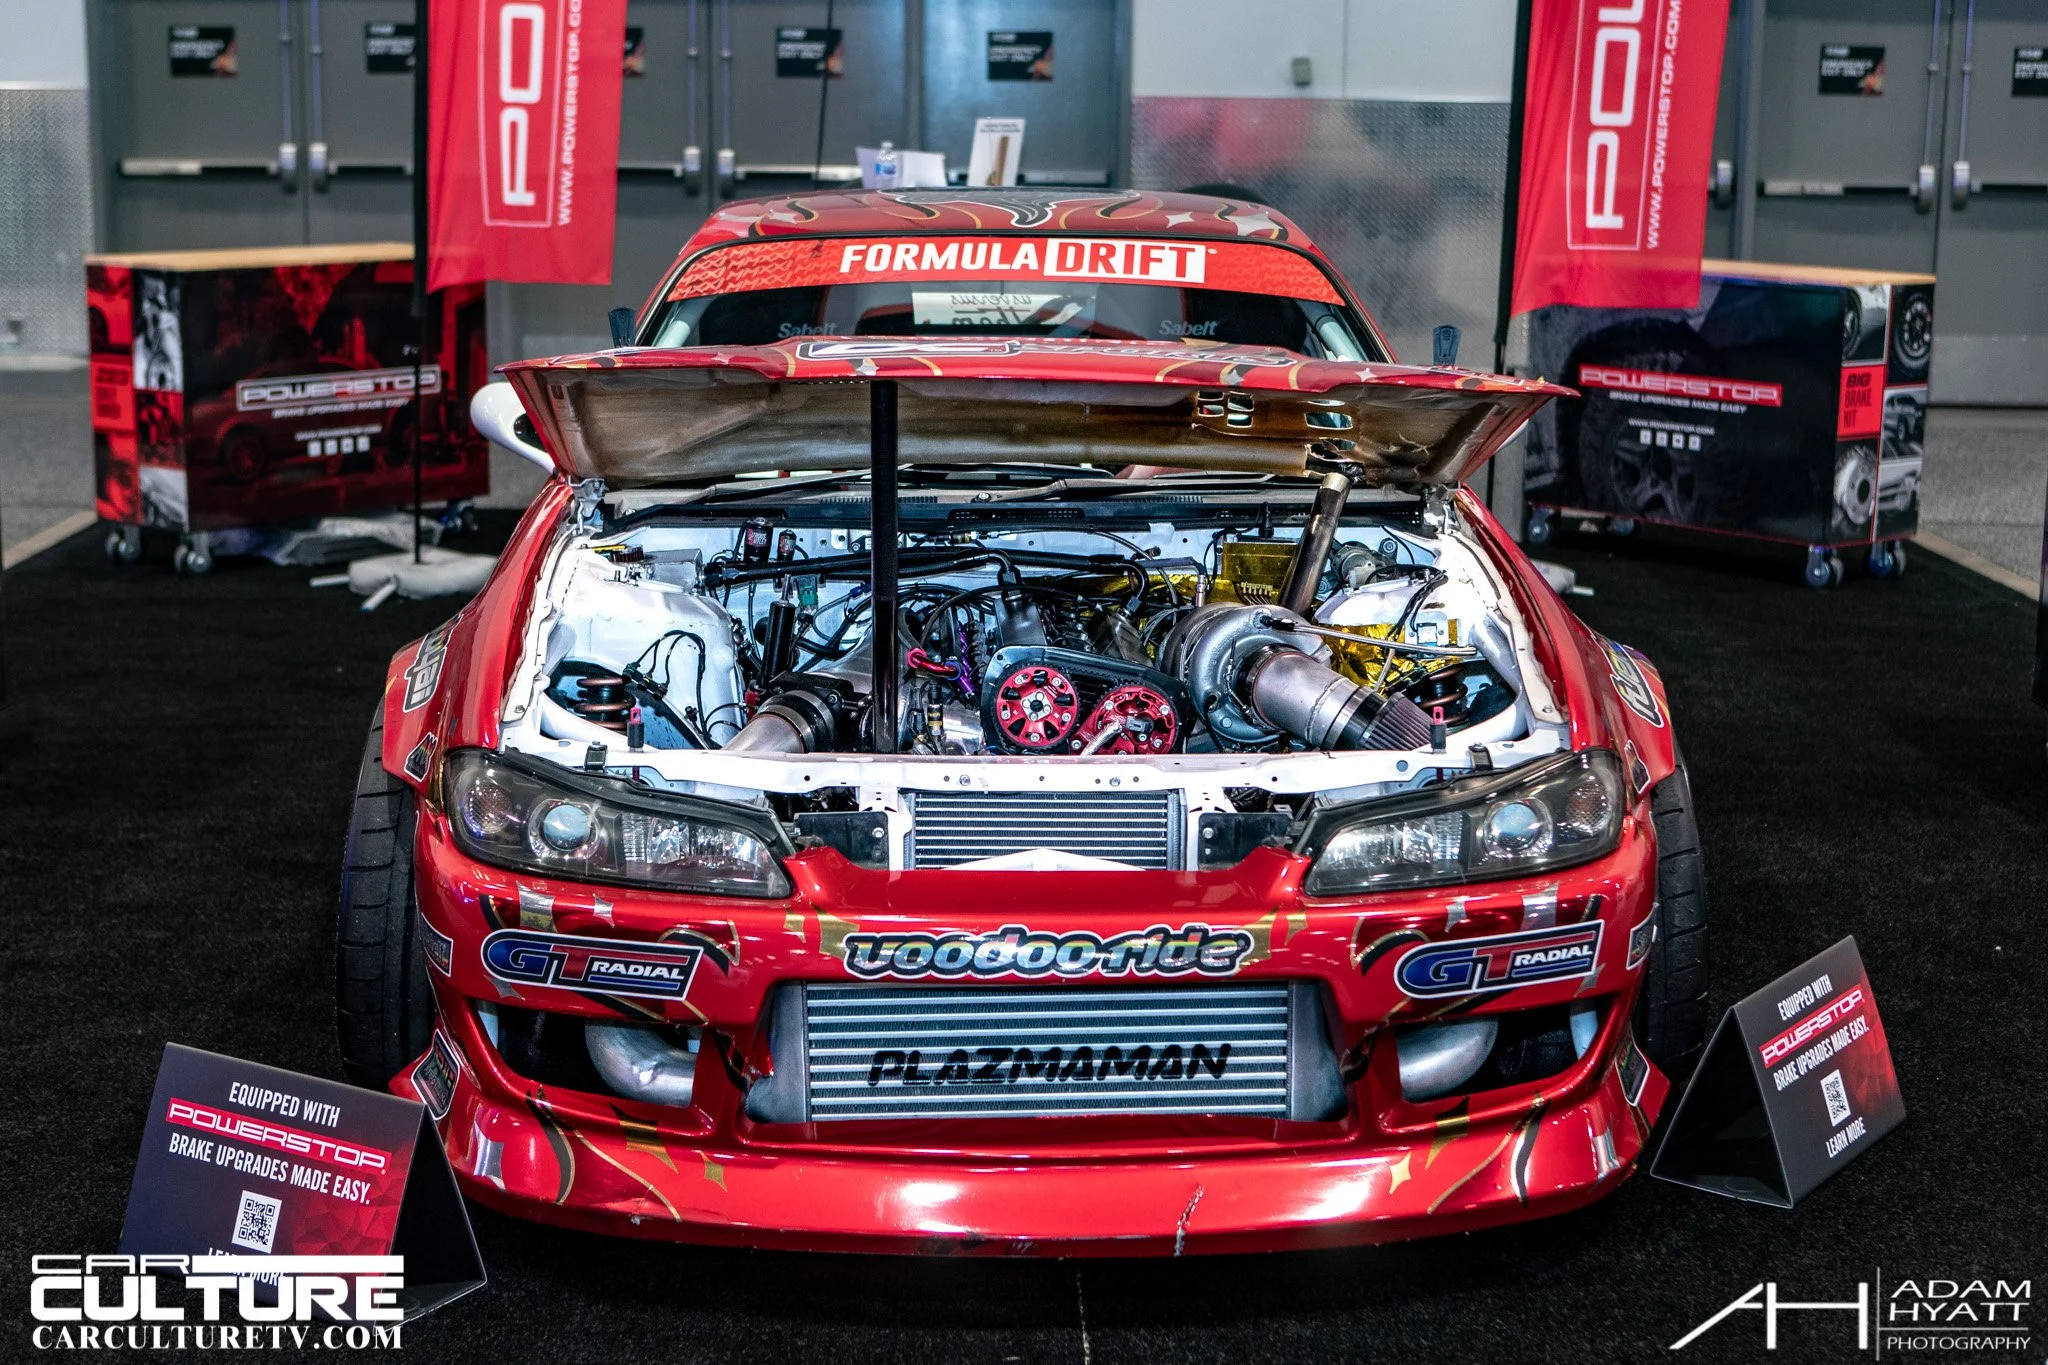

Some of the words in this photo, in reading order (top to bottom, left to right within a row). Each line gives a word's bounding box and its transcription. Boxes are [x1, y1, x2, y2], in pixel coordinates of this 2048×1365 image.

[1647, 0, 1682, 249] WWW.POWERSTOP.COM
[840, 242, 1039, 273] FORMULA
[1056, 242, 1197, 278] DRIFT
[777, 322, 837, 338] Sabelt
[1159, 320, 1218, 336] Sabelt
[1581, 368, 1778, 402] POWERSTOP
[1846, 372, 1872, 388] BIG
[1609, 390, 1640, 404] BRAKE
[1641, 394, 1691, 409] UPGRADES
[1692, 400, 1720, 412] MADE
[1721, 402, 1748, 415] EASY
[1844, 388, 1873, 409] BRAKE
[1843, 409, 1857, 429] KIT
[591, 959, 686, 980] RADIAL
[1514, 944, 1594, 968] RADIAL
[1777, 982, 1815, 1021] EQUIPPED
[1810, 973, 1834, 996] WITH
[1762, 989, 1863, 1064] POWERSTOP
[867, 1043, 1232, 1087] PLAZMAMAN
[1773, 1062, 1801, 1091] BRAKE
[1796, 1037, 1835, 1076] UPGRADES
[1830, 1026, 1853, 1054] MADE
[1849, 1015, 1870, 1042] EASY.
[229, 1081, 300, 1119] EQUIPPED
[303, 1099, 341, 1128] WITH
[168, 1104, 387, 1168] POWERSTOP
[1825, 1127, 1849, 1159] LEARN
[1846, 1117, 1867, 1144] MORE
[168, 1132, 213, 1163] BRAKE
[215, 1144, 288, 1183] UPGRADES
[290, 1166, 330, 1195] MADE
[333, 1175, 371, 1205] EASY.
